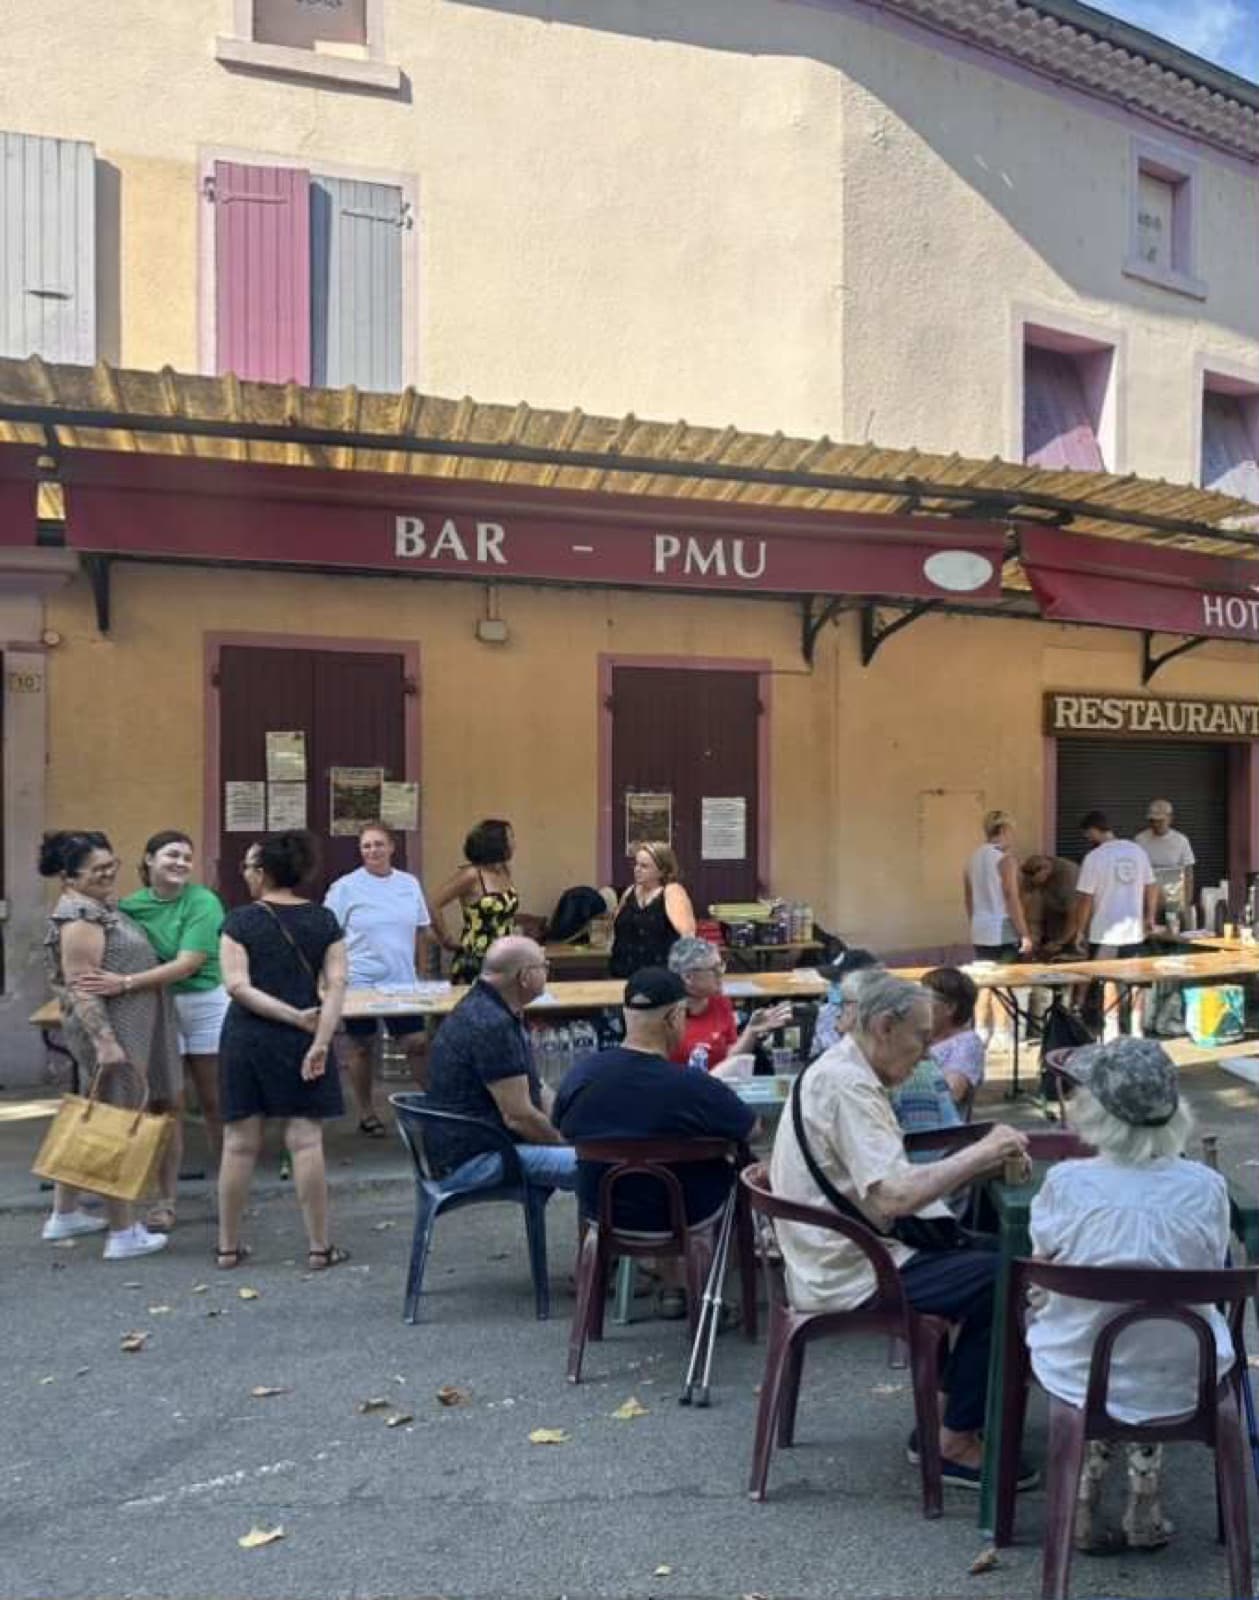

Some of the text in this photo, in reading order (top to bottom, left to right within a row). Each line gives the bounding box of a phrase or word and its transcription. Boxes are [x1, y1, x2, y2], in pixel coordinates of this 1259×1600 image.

[394, 515, 508, 564] BAR
[653, 534, 767, 579] PMU
[1202, 594, 1259, 630] HOT
[1053, 696, 1259, 735] RESTAURANT
